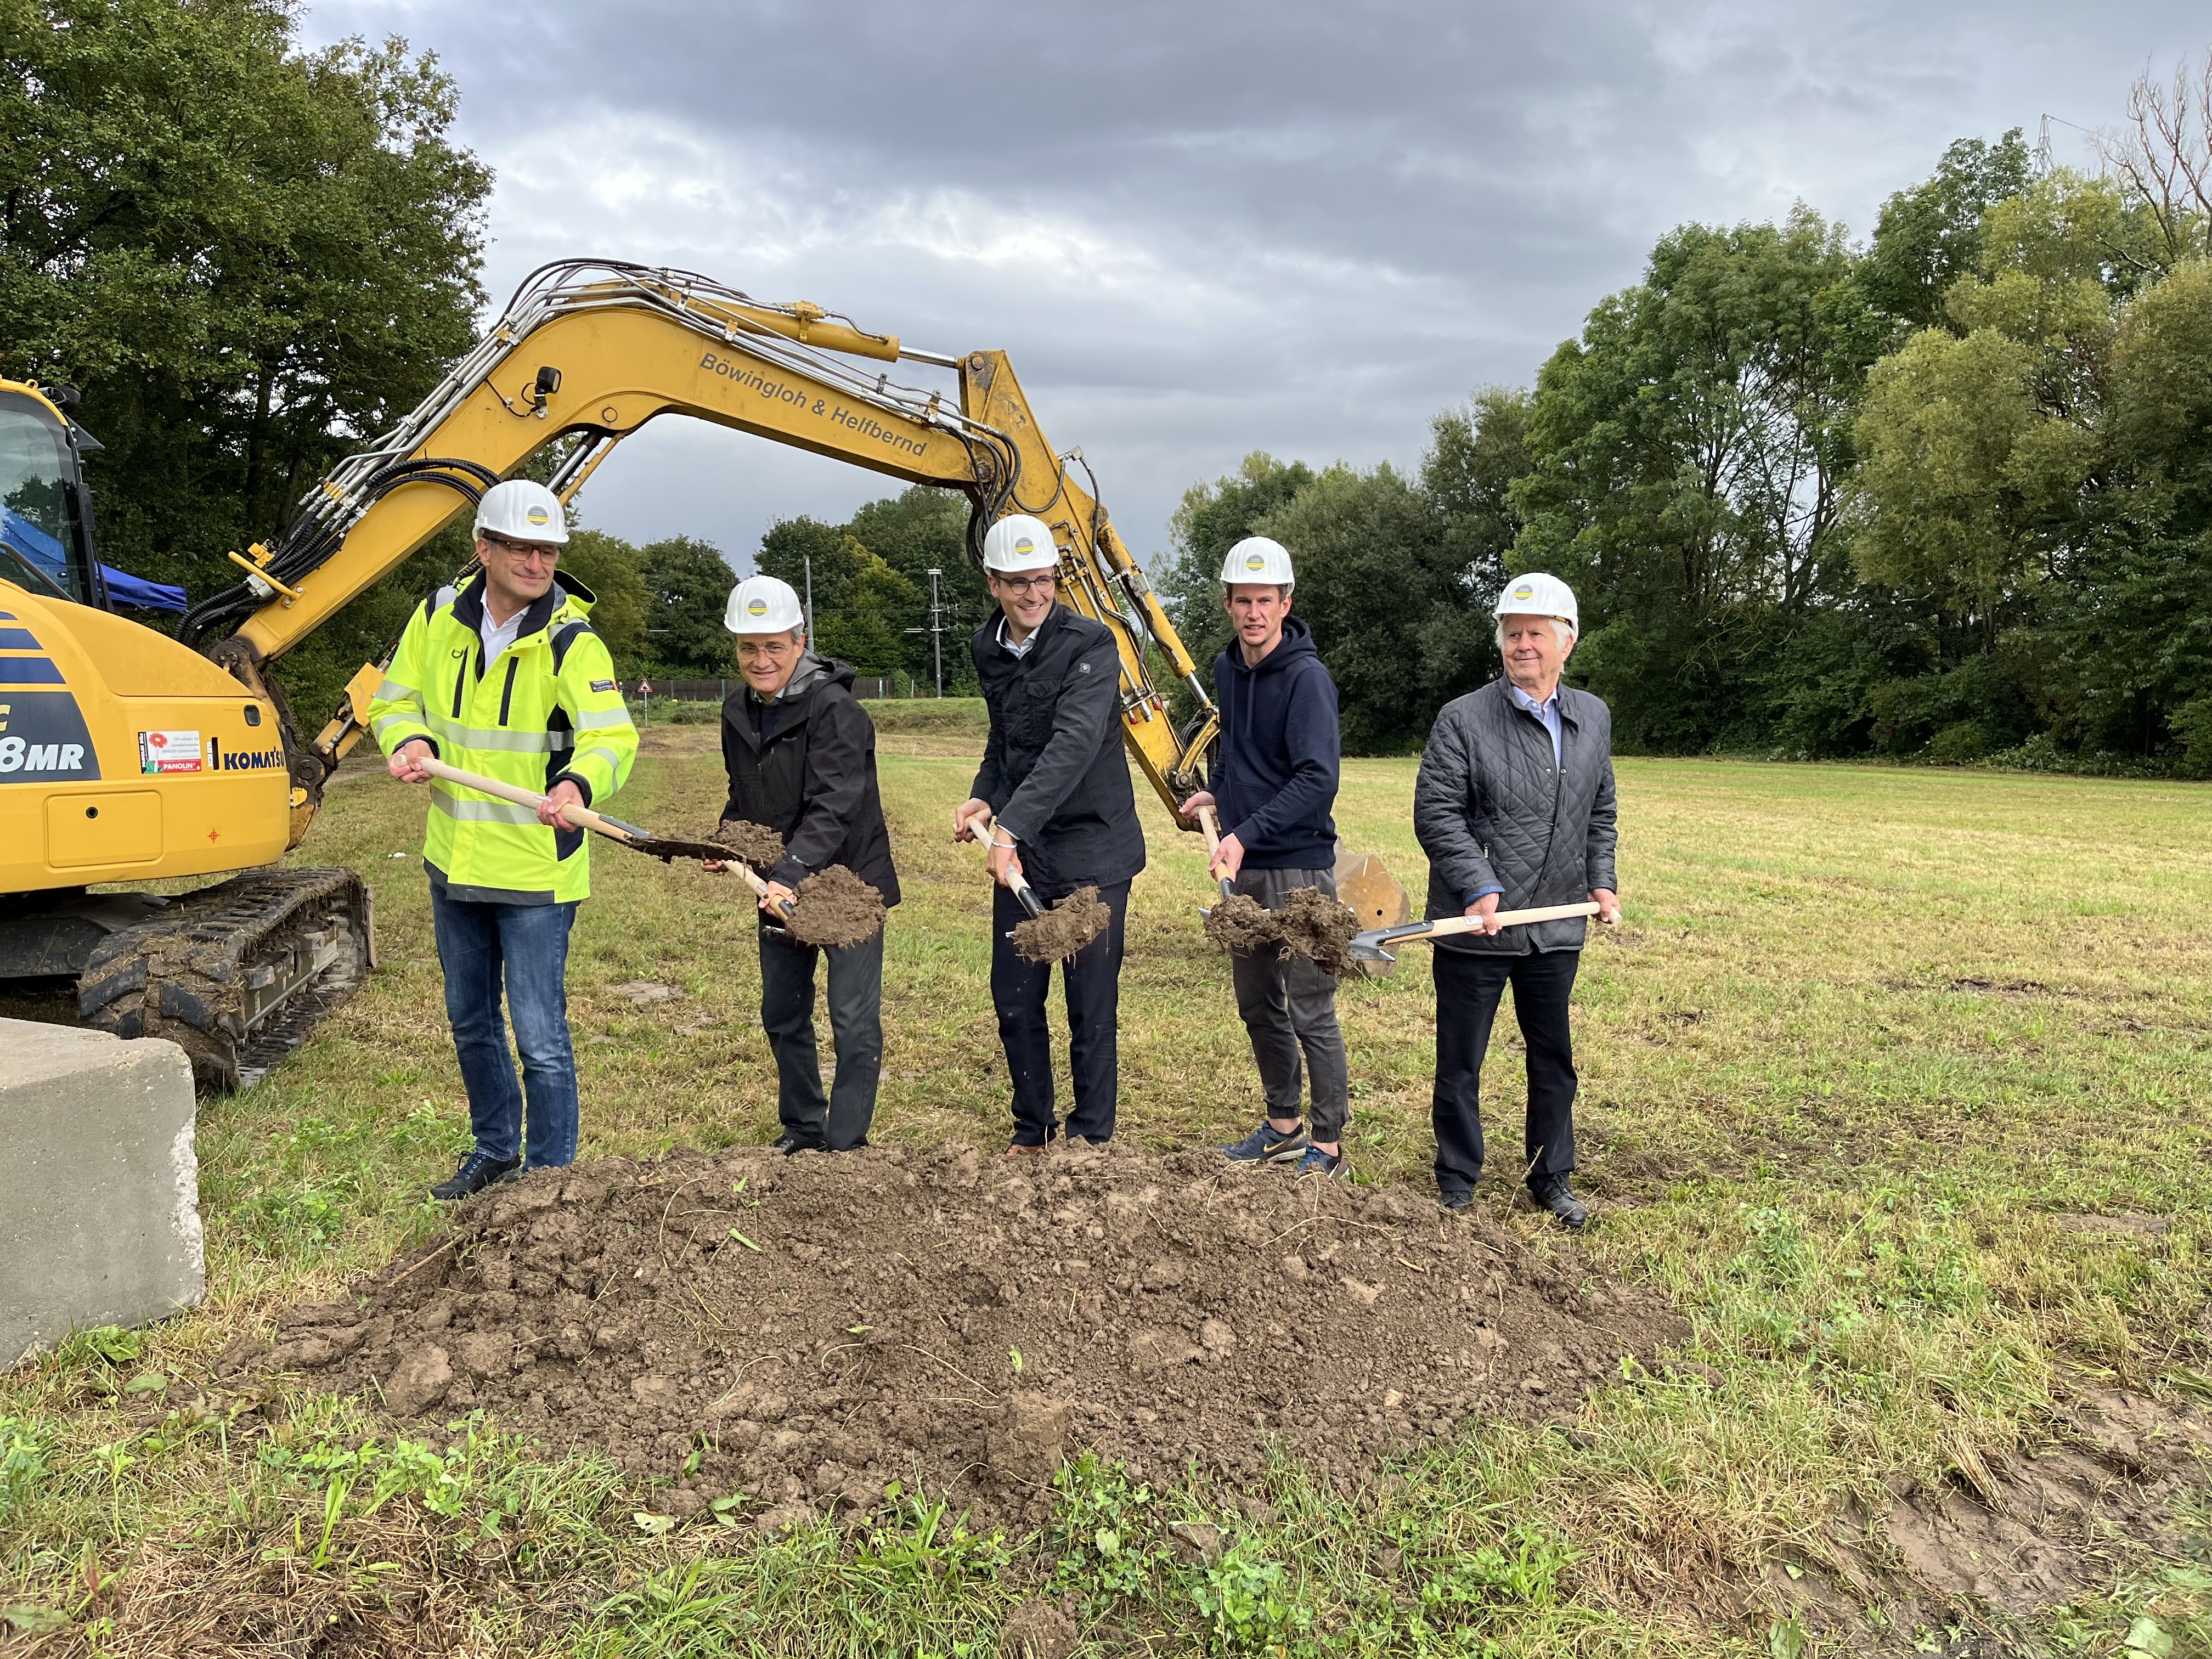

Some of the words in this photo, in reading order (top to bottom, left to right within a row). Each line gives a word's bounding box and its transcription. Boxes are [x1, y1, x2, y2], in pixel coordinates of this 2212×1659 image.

[699, 352, 807, 408] Böwingloh
[811, 399, 825, 416] &
[831, 407, 927, 456] Helfbernd
[0, 736, 84, 772] 8MR
[224, 746, 284, 770] KOMATSU
